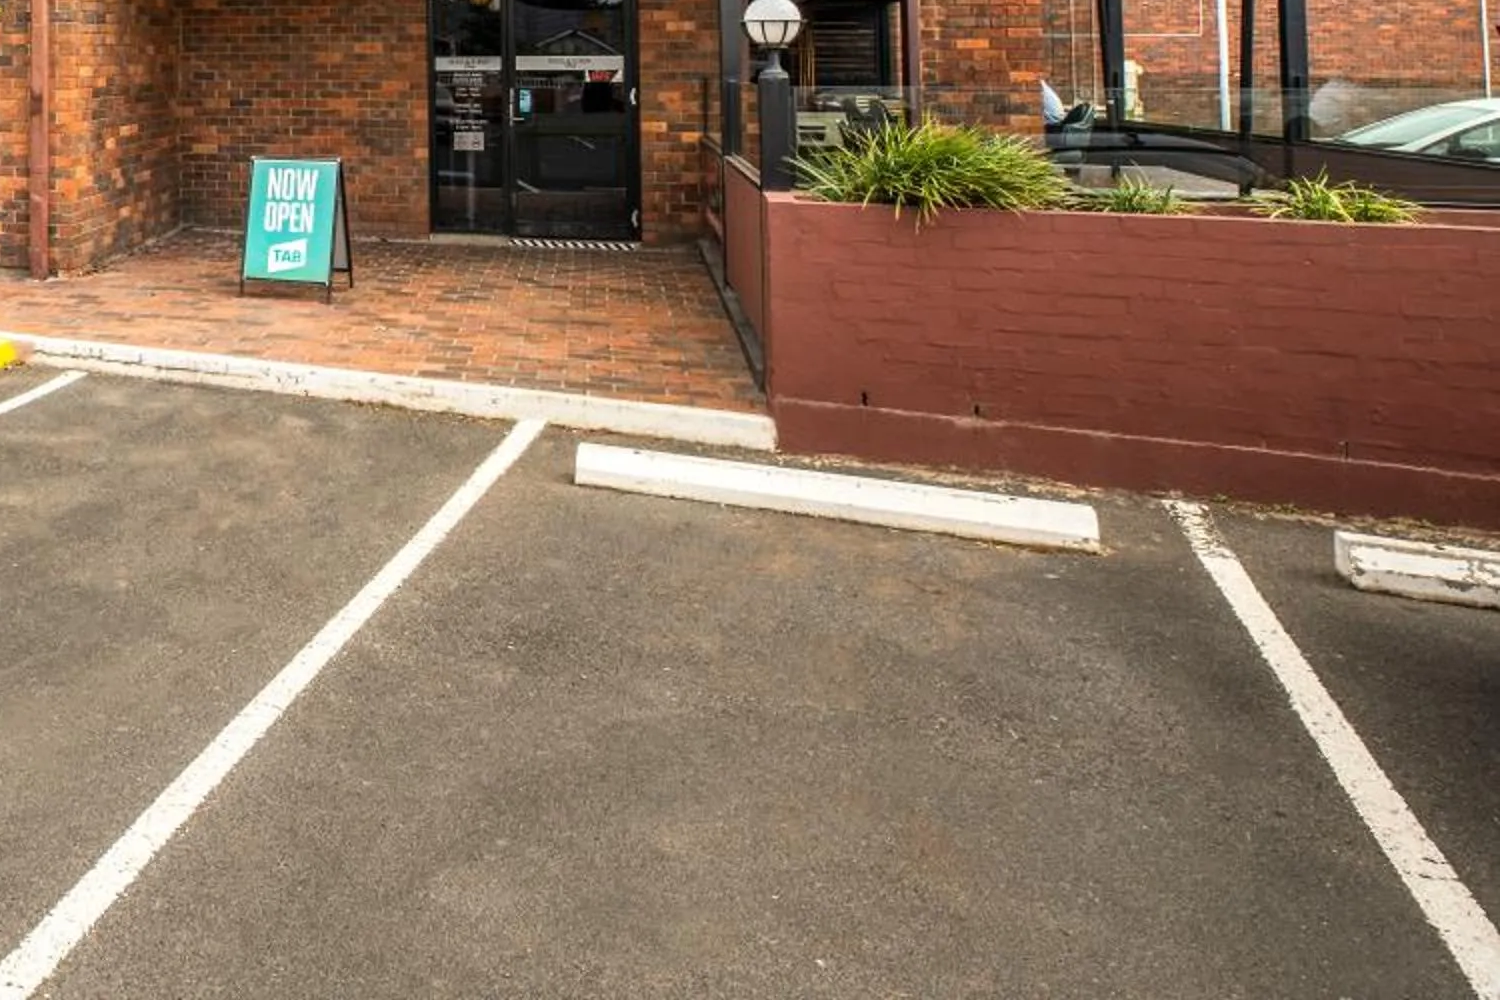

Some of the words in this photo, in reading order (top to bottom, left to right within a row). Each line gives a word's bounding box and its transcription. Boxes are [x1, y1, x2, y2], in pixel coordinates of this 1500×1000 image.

[267, 167, 319, 201] NOW
[263, 201, 315, 234] OPEN
[273, 249, 302, 263] TAB
